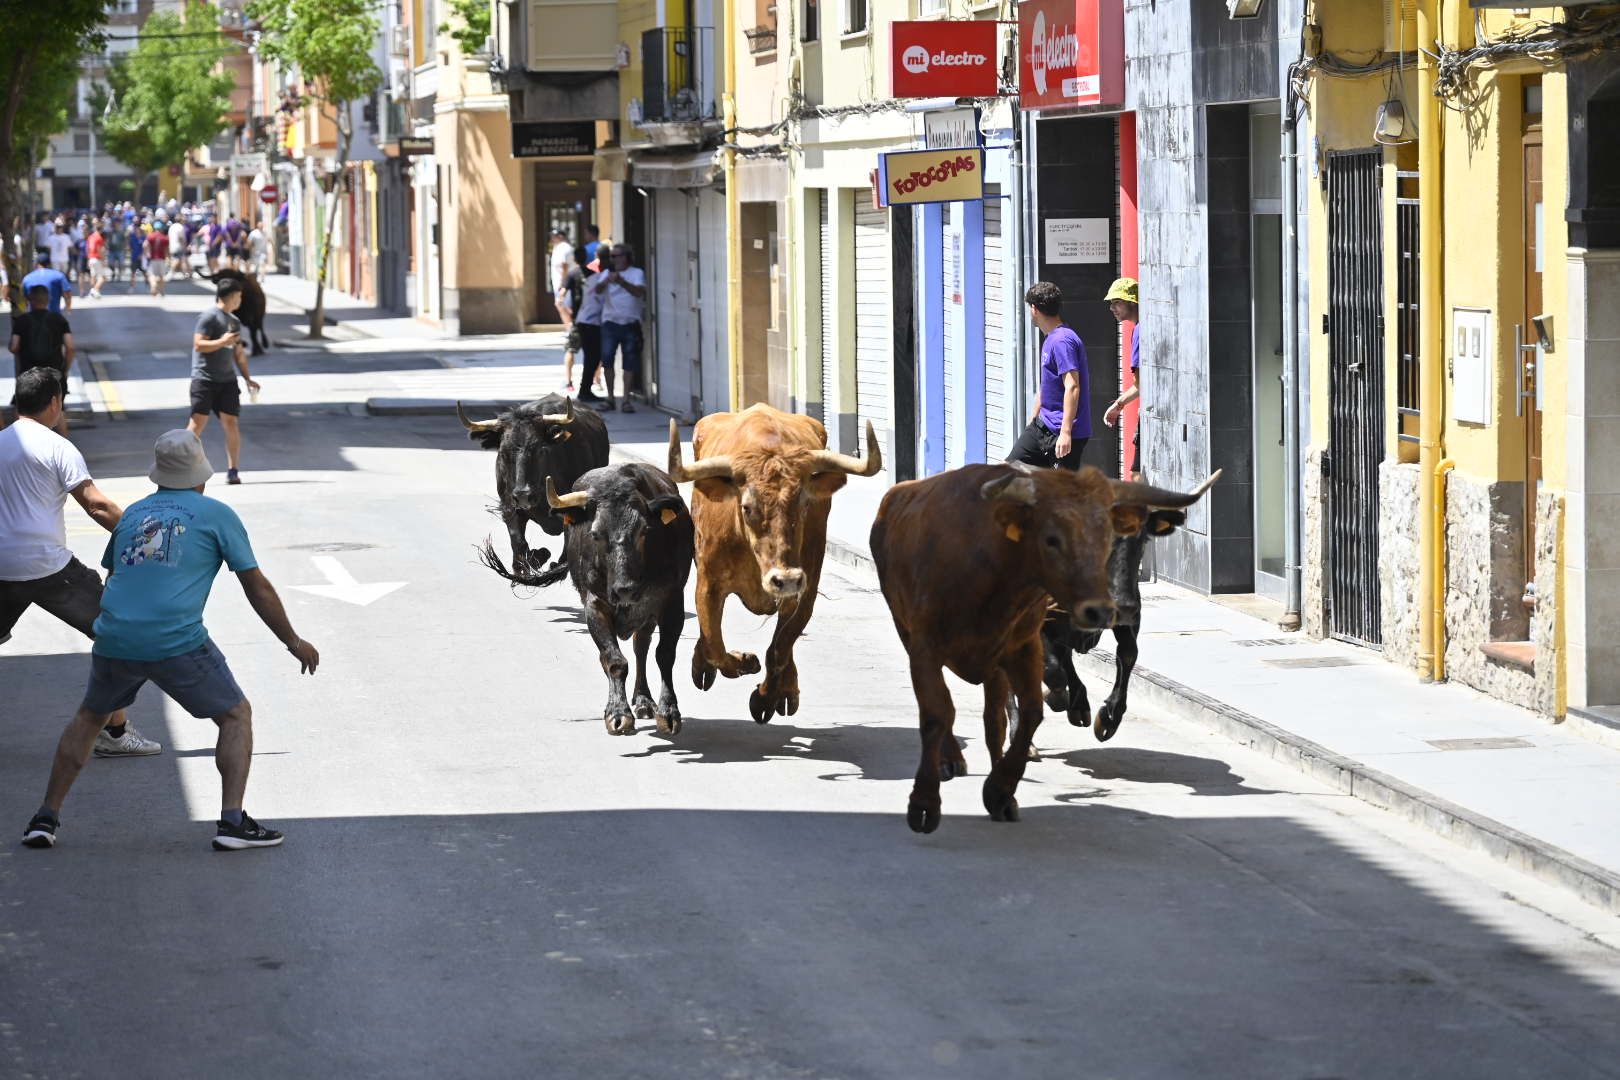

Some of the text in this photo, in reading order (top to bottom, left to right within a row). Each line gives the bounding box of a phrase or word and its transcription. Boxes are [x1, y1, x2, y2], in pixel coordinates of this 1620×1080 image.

[907, 50, 988, 66] mi electro
[1034, 23, 1079, 71] mi electro
[893, 155, 976, 196] FOTOCOPIAS
